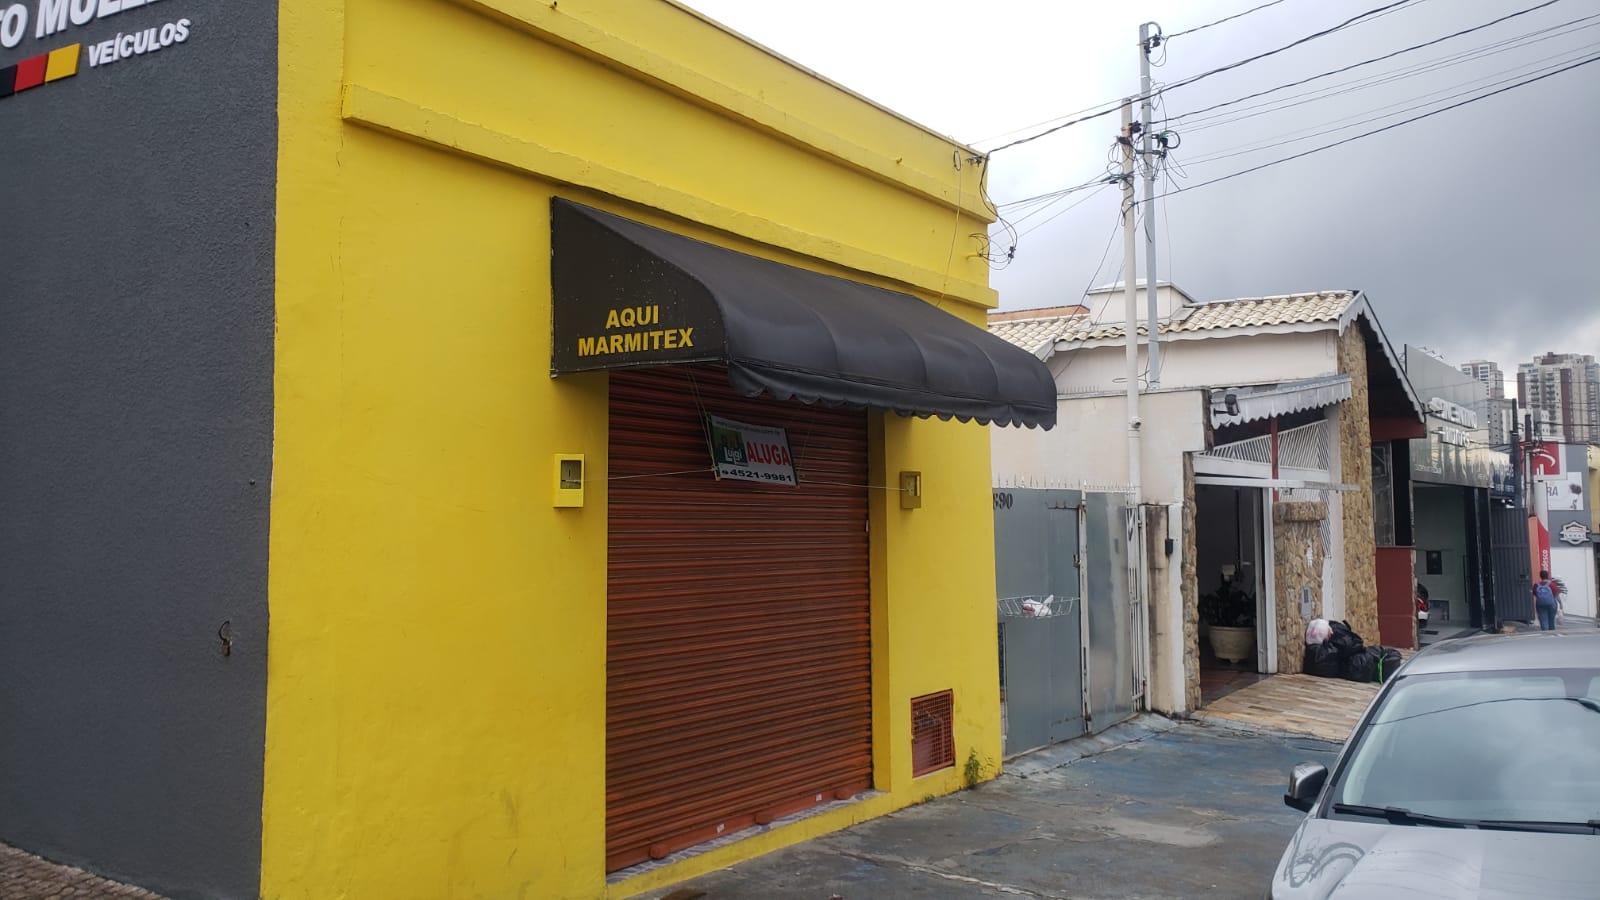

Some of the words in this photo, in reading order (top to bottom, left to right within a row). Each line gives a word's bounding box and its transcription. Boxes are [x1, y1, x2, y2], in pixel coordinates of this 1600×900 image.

[0, 4, 28, 48] O
[88, 18, 191, 67] VEÍCULOS
[605, 304, 660, 330] AQUI
[578, 327, 694, 357] MARMITEX
[746, 441, 793, 466] ALUGA
